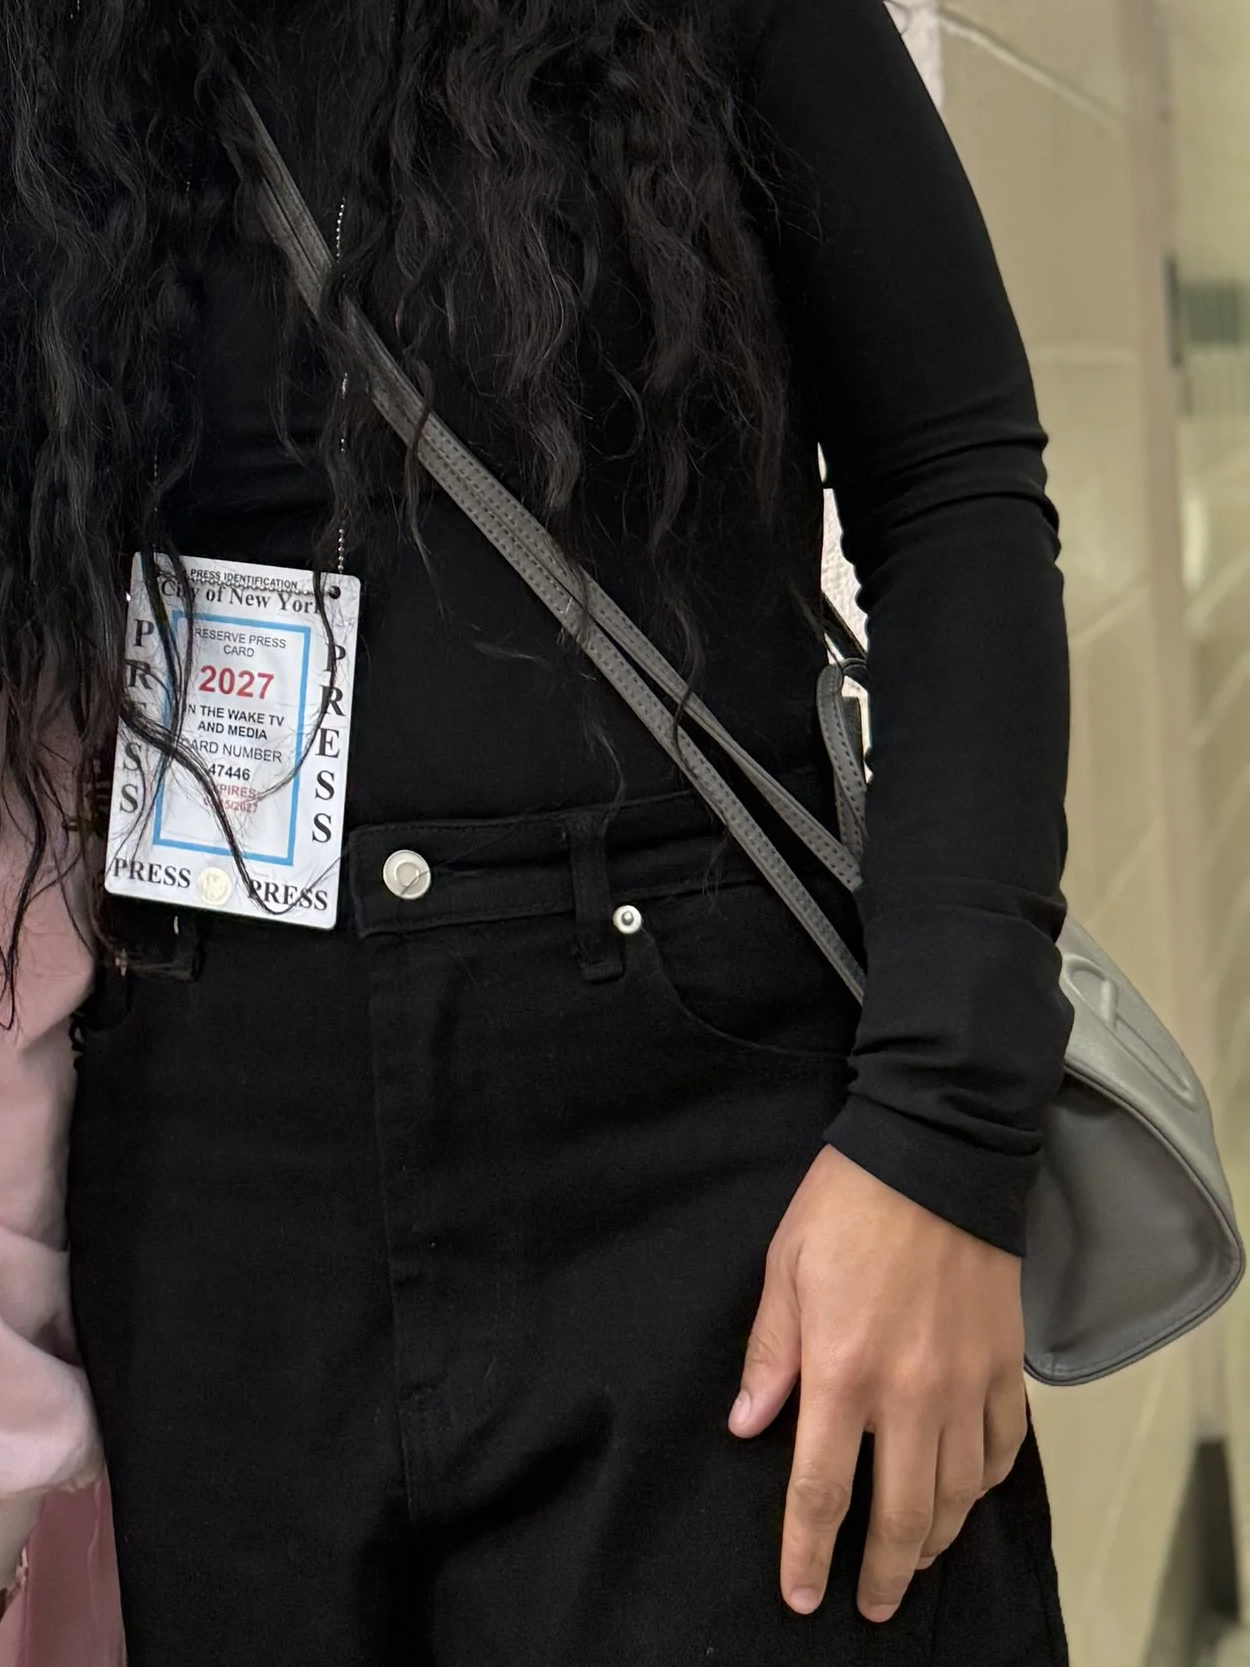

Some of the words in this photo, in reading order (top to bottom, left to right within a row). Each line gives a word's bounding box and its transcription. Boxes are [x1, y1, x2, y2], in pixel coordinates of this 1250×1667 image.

[190, 568, 221, 580] PRESS
[224, 572, 298, 589] IDENTIFICATION
[161, 579, 200, 602] Ciy
[206, 585, 226, 603] of
[229, 588, 271, 608] New
[195, 628, 246, 644] RESERVE
[248, 634, 287, 649] PRESS
[223, 644, 255, 658] CARD
[198, 664, 275, 700] 2027
[119, 618, 155, 814] PRSS
[200, 704, 225, 719] THE
[227, 708, 266, 725] WAKE
[268, 714, 285, 727] TV
[197, 720, 225, 734] AND
[227, 724, 268, 741] MEDIA
[222, 742, 283, 763] NUMBER
[311, 643, 347, 844] PRESS
[208, 763, 251, 781] 47446
[113, 857, 192, 889] PRESS
[247, 878, 329, 911] PRESS
